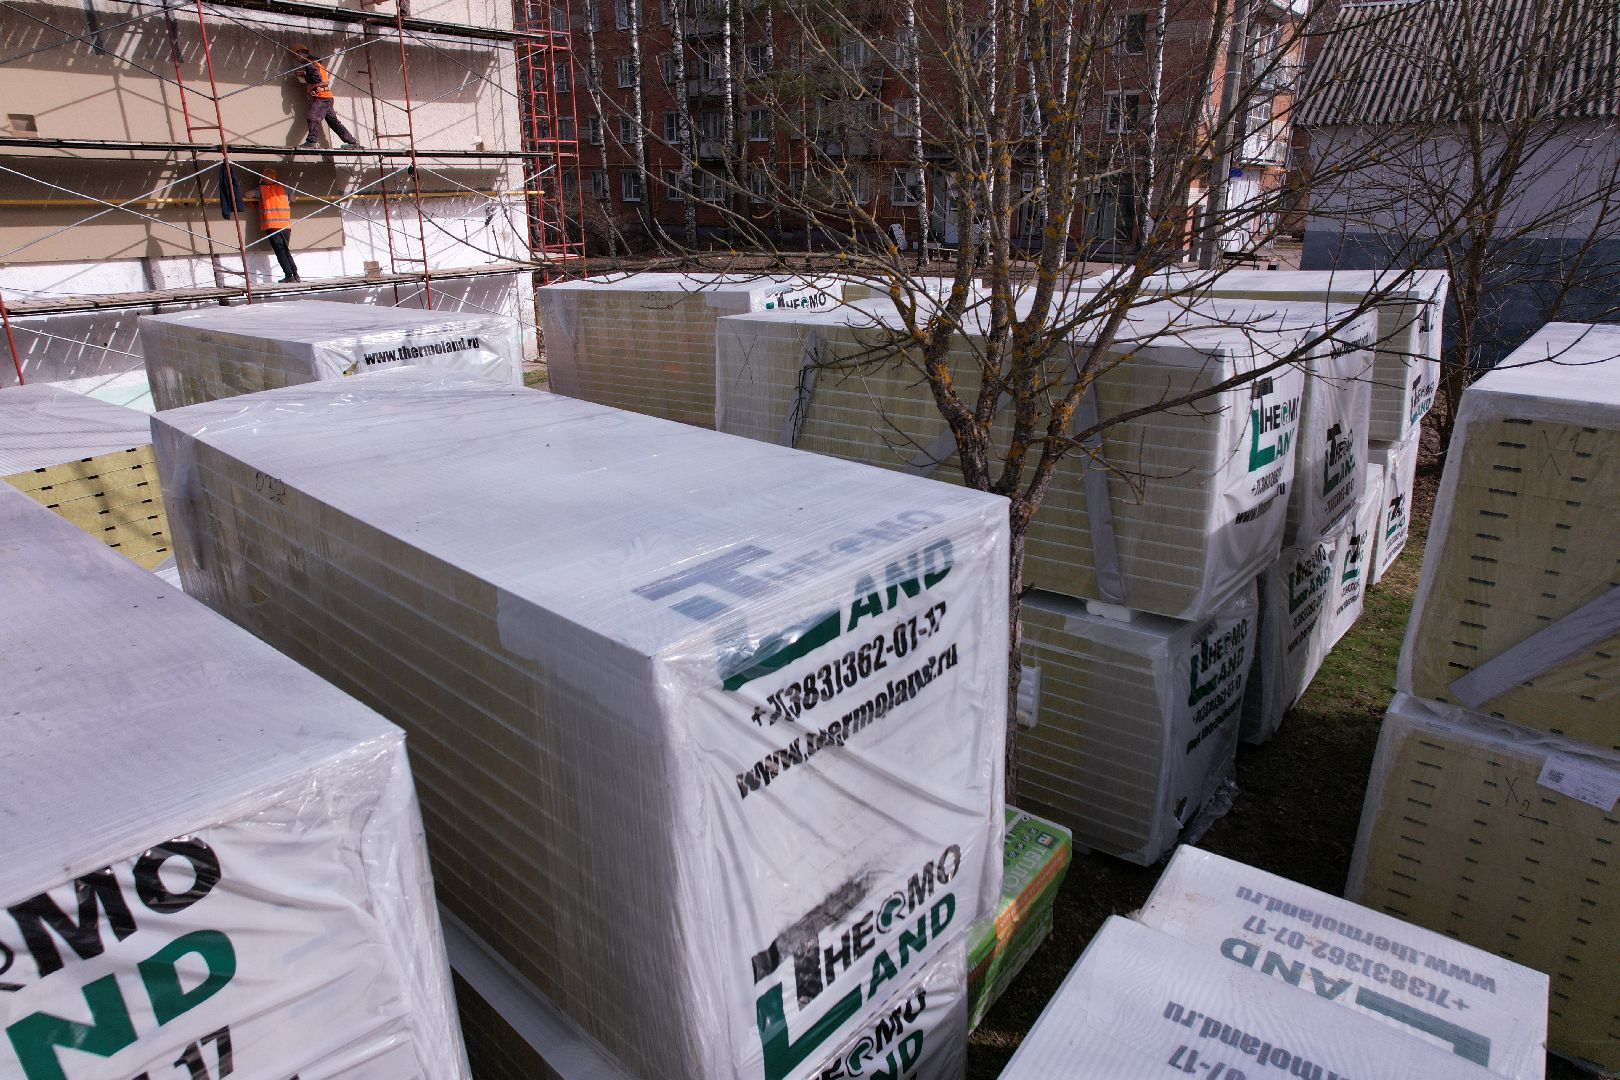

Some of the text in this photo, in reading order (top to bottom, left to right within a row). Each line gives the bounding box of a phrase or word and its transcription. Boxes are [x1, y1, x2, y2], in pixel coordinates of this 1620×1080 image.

[363, 337, 480, 366] www.thermoland.ru
[736, 643, 958, 800] www.thermoland.ru
[1236, 885, 1497, 995] www.thermoland.ru
